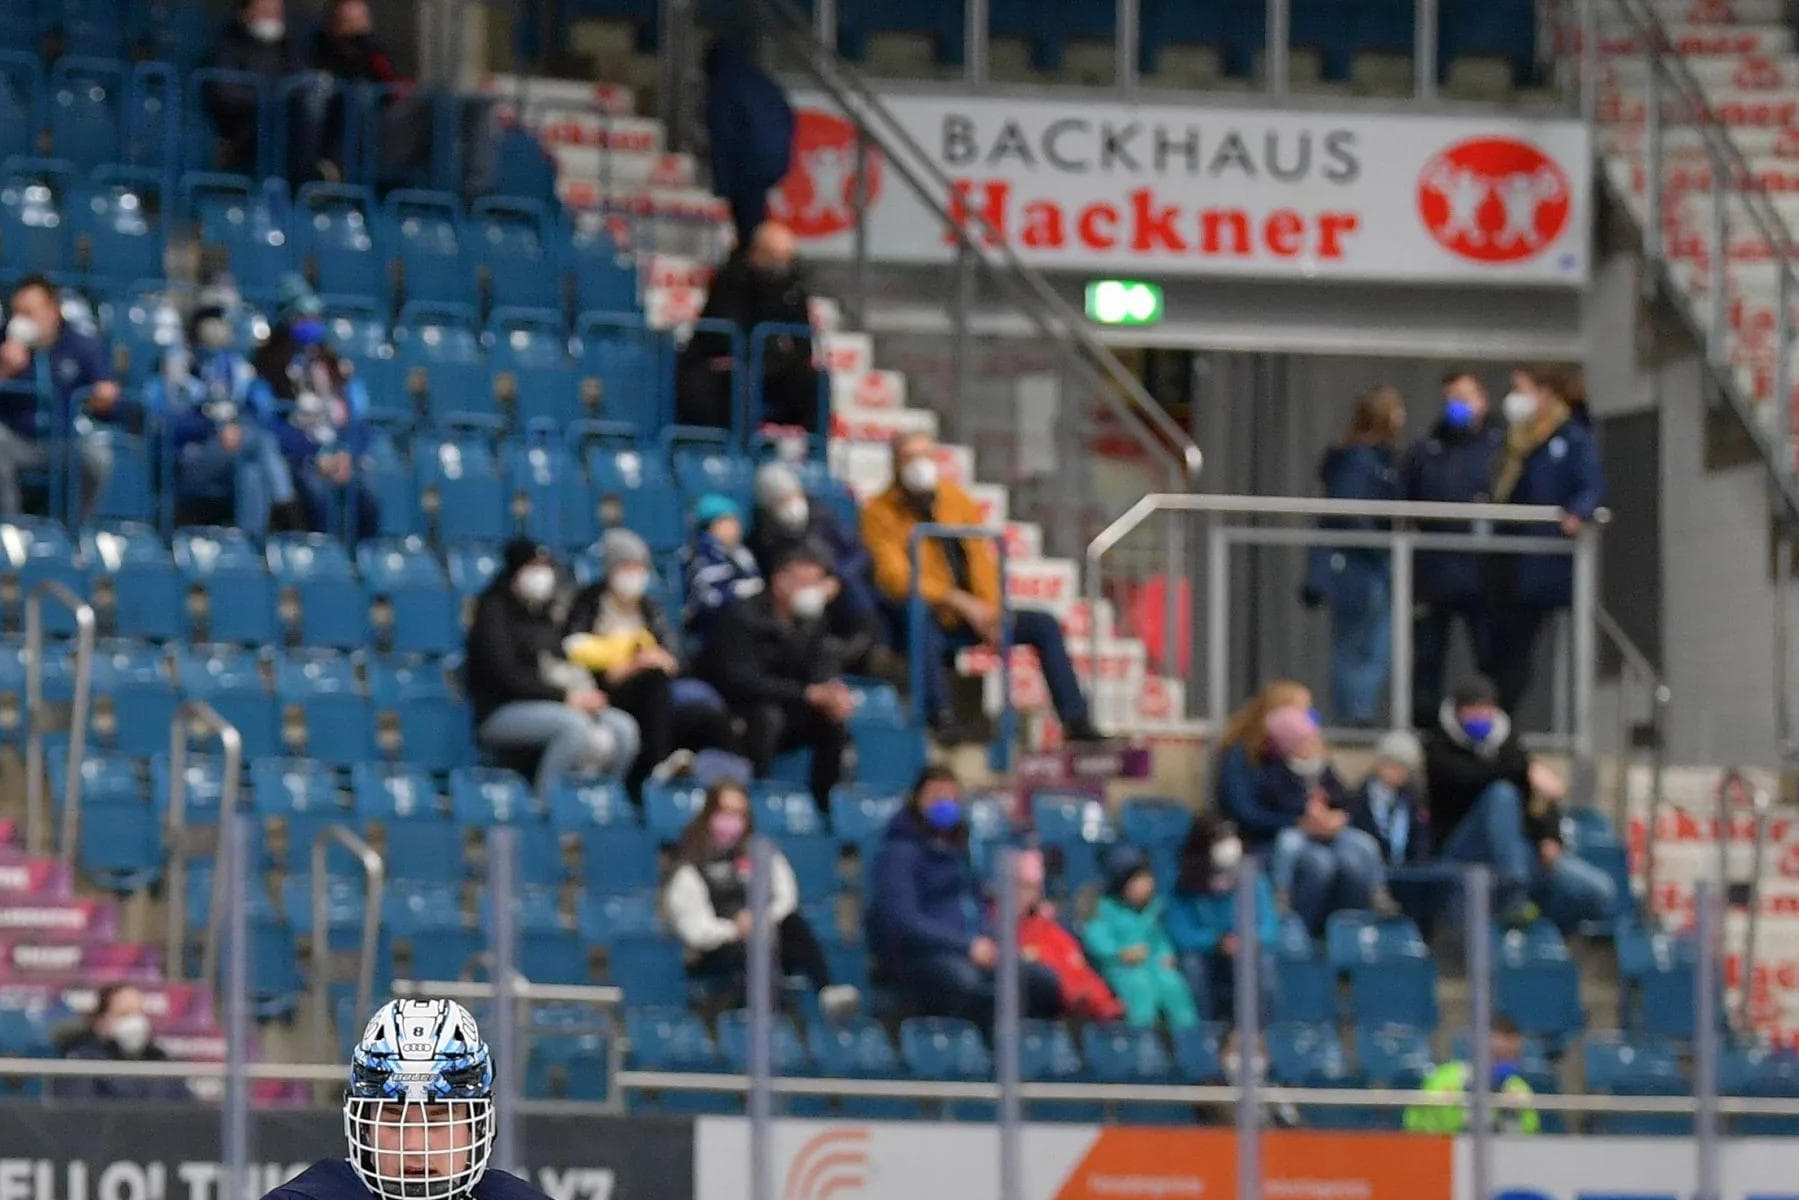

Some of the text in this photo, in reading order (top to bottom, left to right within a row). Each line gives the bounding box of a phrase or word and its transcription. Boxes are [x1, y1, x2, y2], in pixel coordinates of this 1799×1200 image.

[941, 113, 1361, 184] BACKHAUS
[944, 178, 1359, 259] Hackner
[412, 1026, 425, 1037] 8
